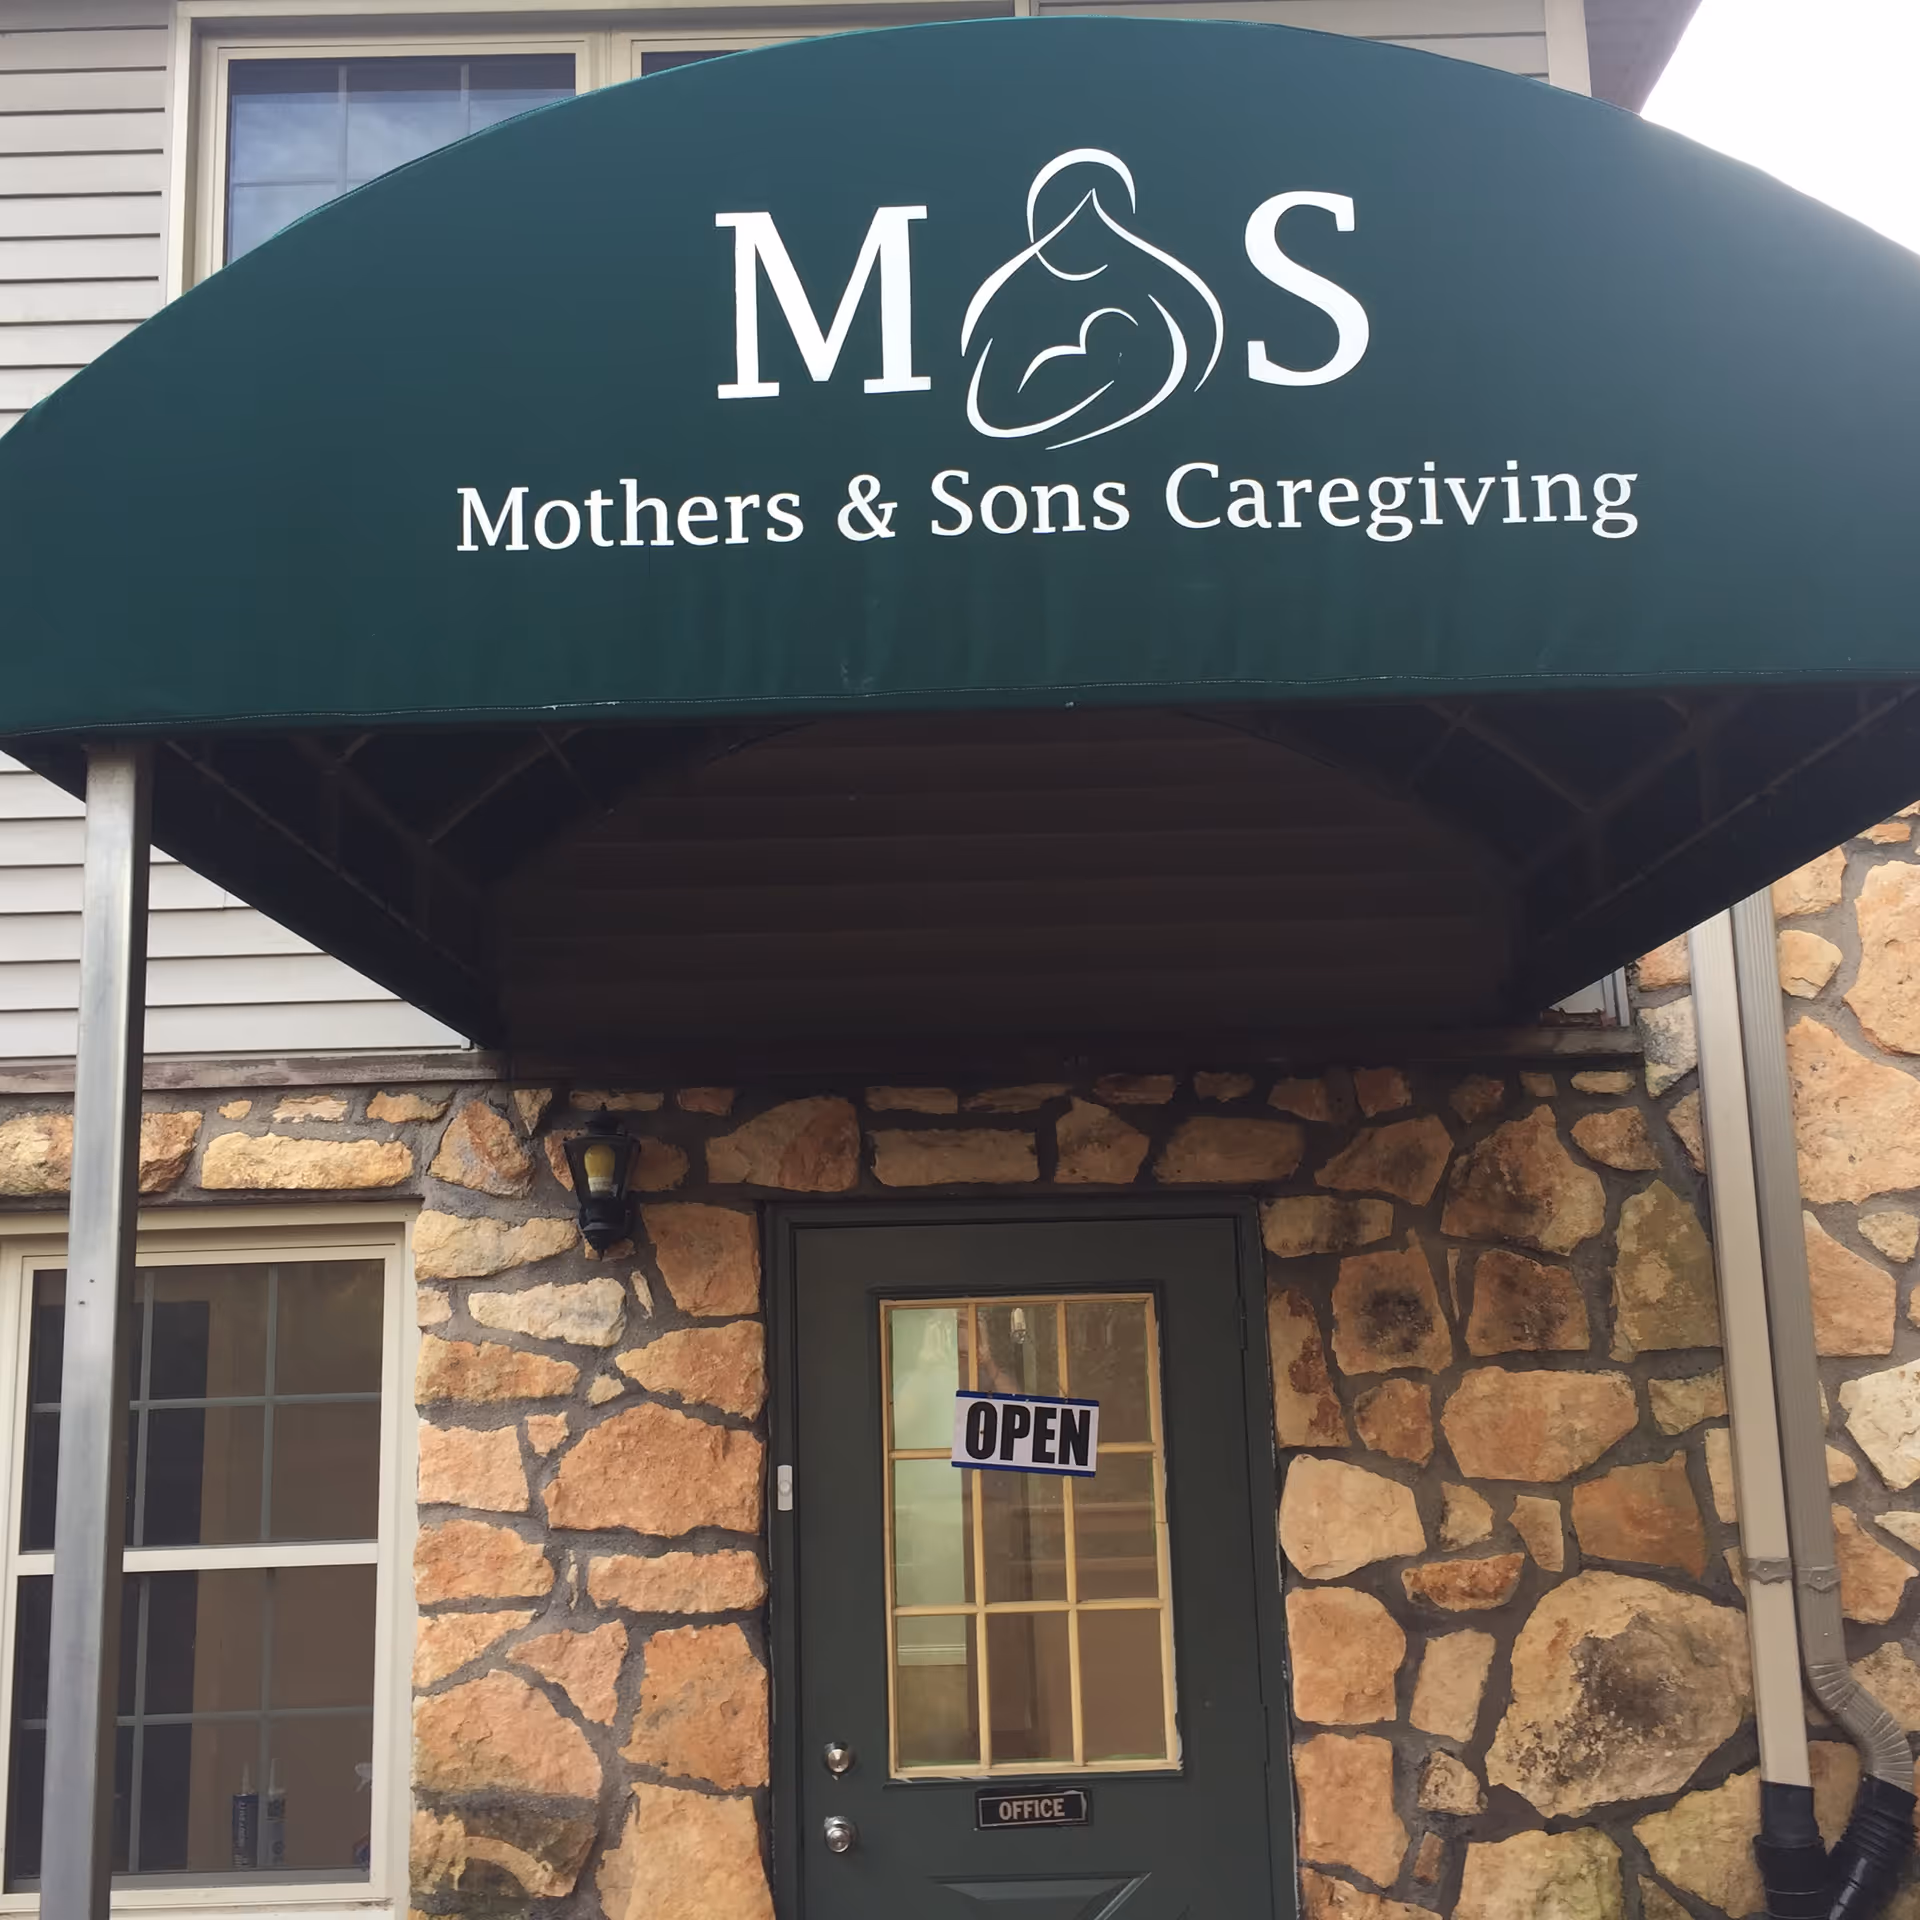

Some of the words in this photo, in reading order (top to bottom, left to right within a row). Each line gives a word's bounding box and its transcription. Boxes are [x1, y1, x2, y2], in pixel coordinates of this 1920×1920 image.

[715, 205, 932, 400] M
[1244, 190, 1370, 387] S
[456, 478, 804, 552] Mothers
[837, 474, 898, 542] &
[931, 469, 1131, 536] Sons
[1165, 459, 1638, 542] Caregiving
[965, 1401, 1091, 1466] OPEN
[998, 1797, 1066, 1821] OFFICE
